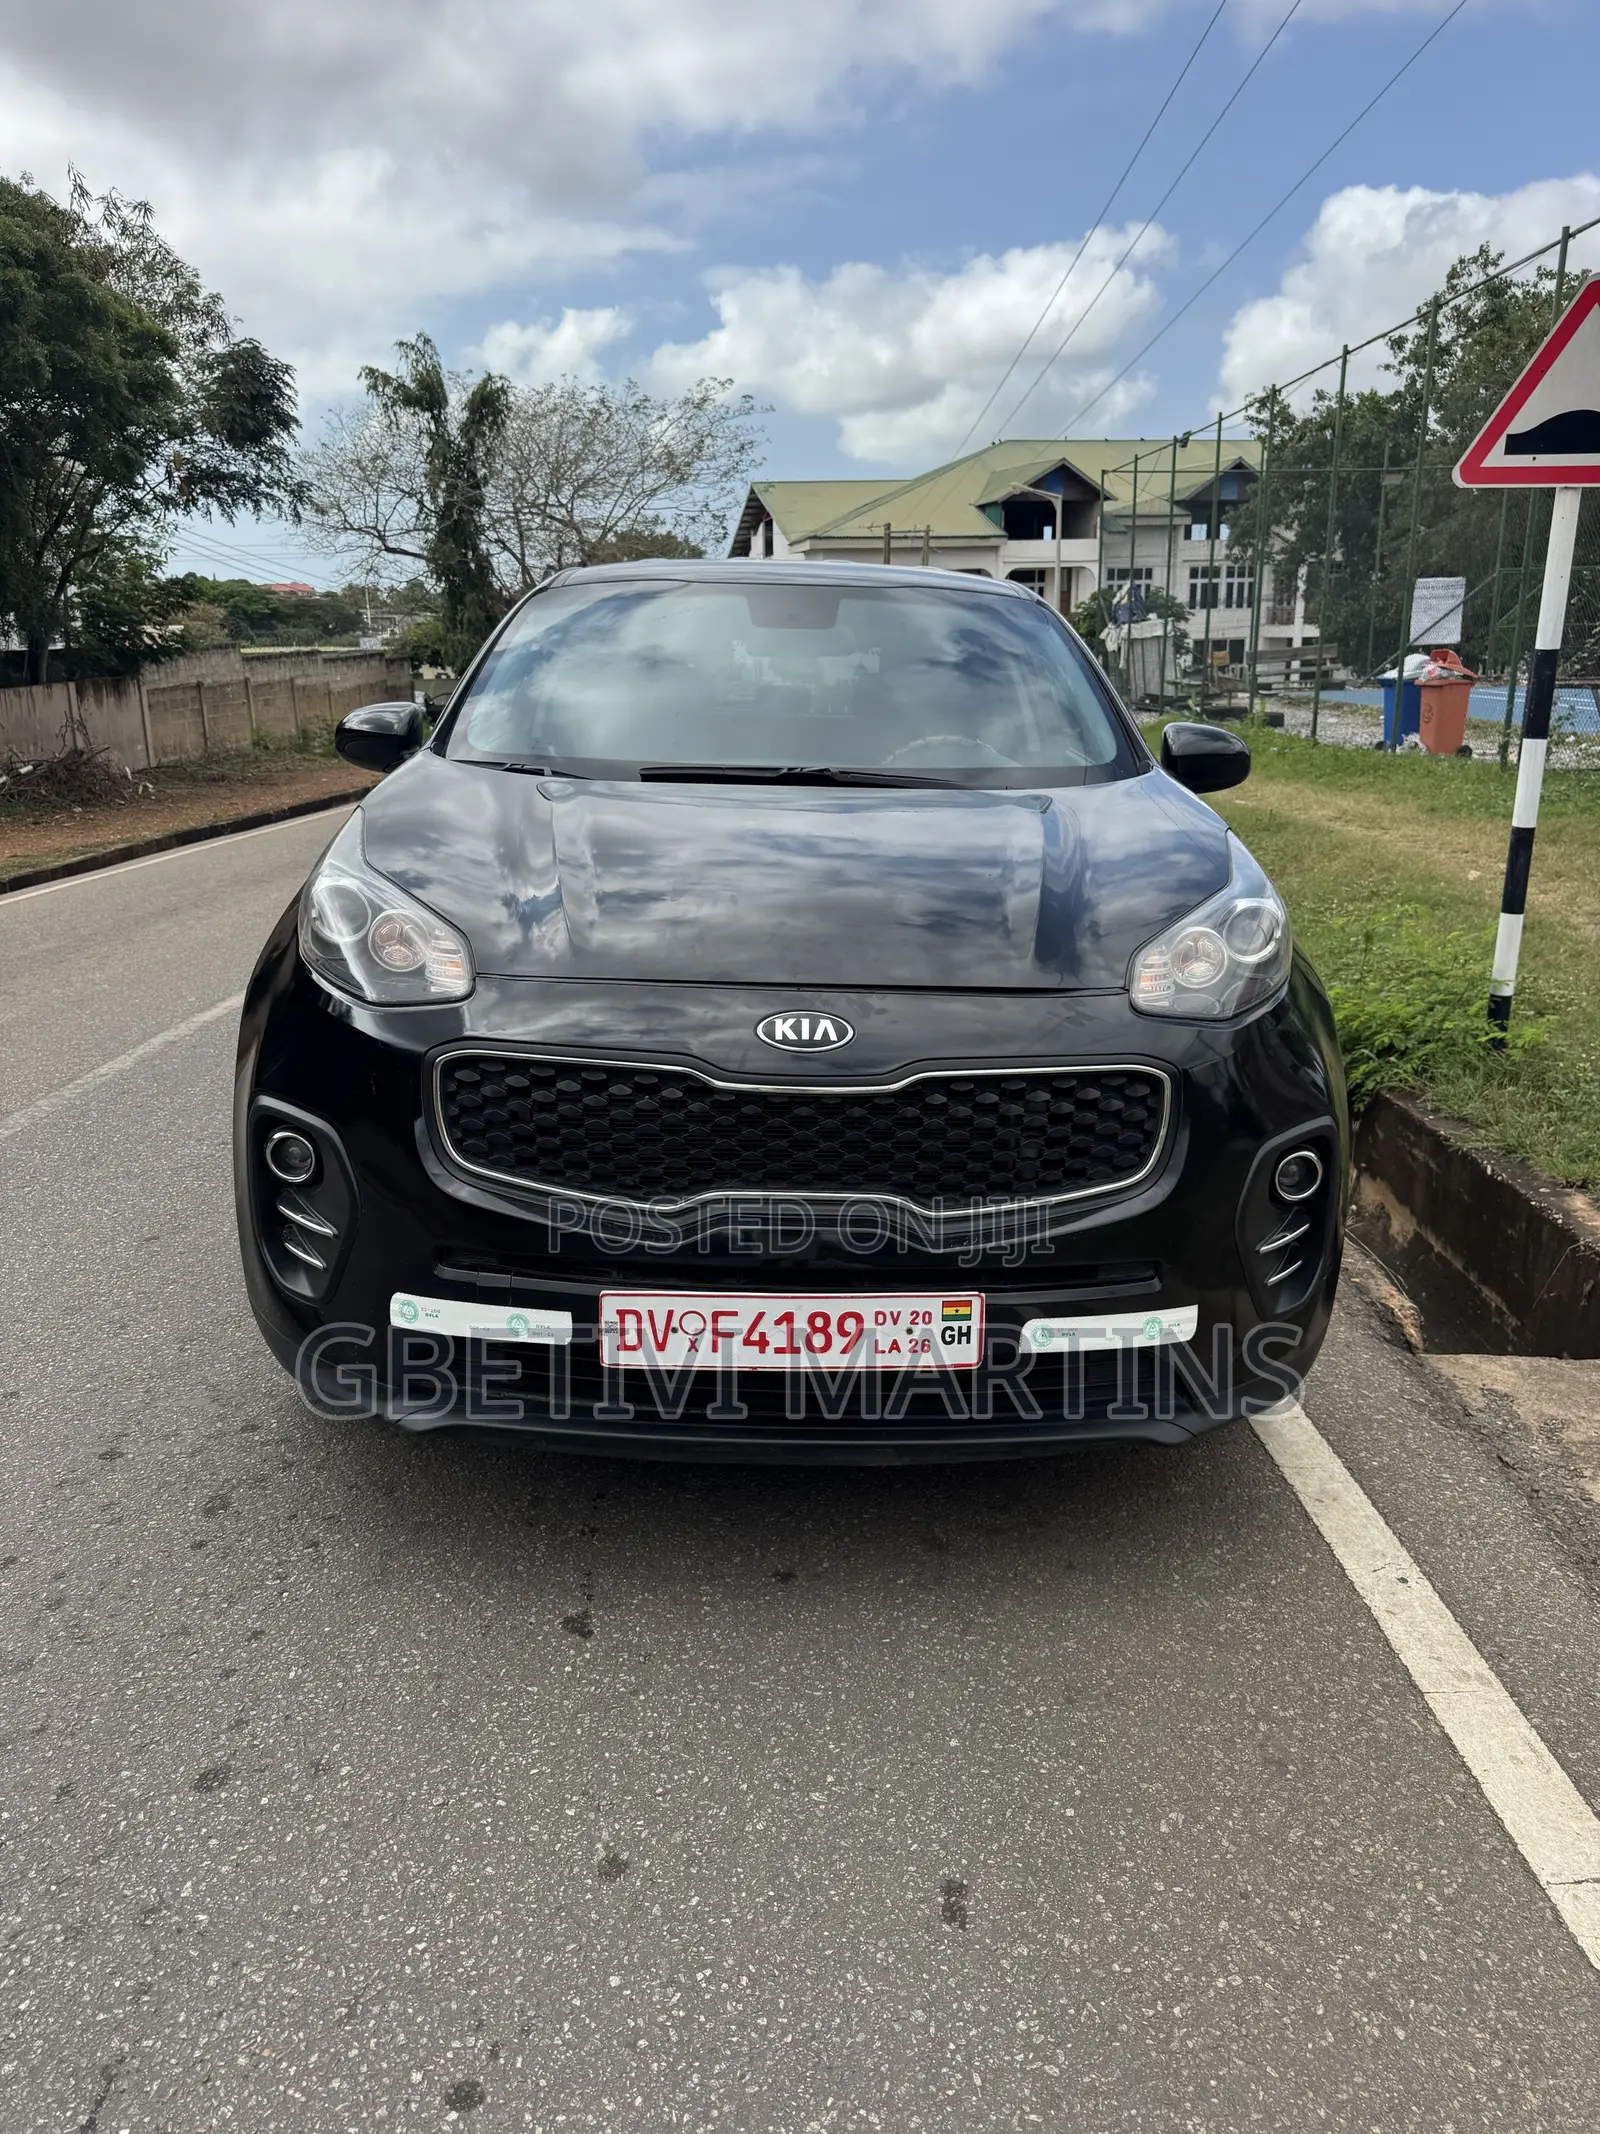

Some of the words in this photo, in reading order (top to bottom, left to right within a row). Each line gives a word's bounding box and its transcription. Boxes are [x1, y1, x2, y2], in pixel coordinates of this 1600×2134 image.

[773, 1017, 838, 1042] KIA
[874, 1310, 901, 1327] DV
[908, 1310, 933, 1326] 20
[615, 1308, 674, 1352] DV
[710, 1310, 865, 1355] F4189
[940, 1325, 972, 1346] GH
[874, 1338, 900, 1354] LA
[908, 1338, 932, 1354] 26
